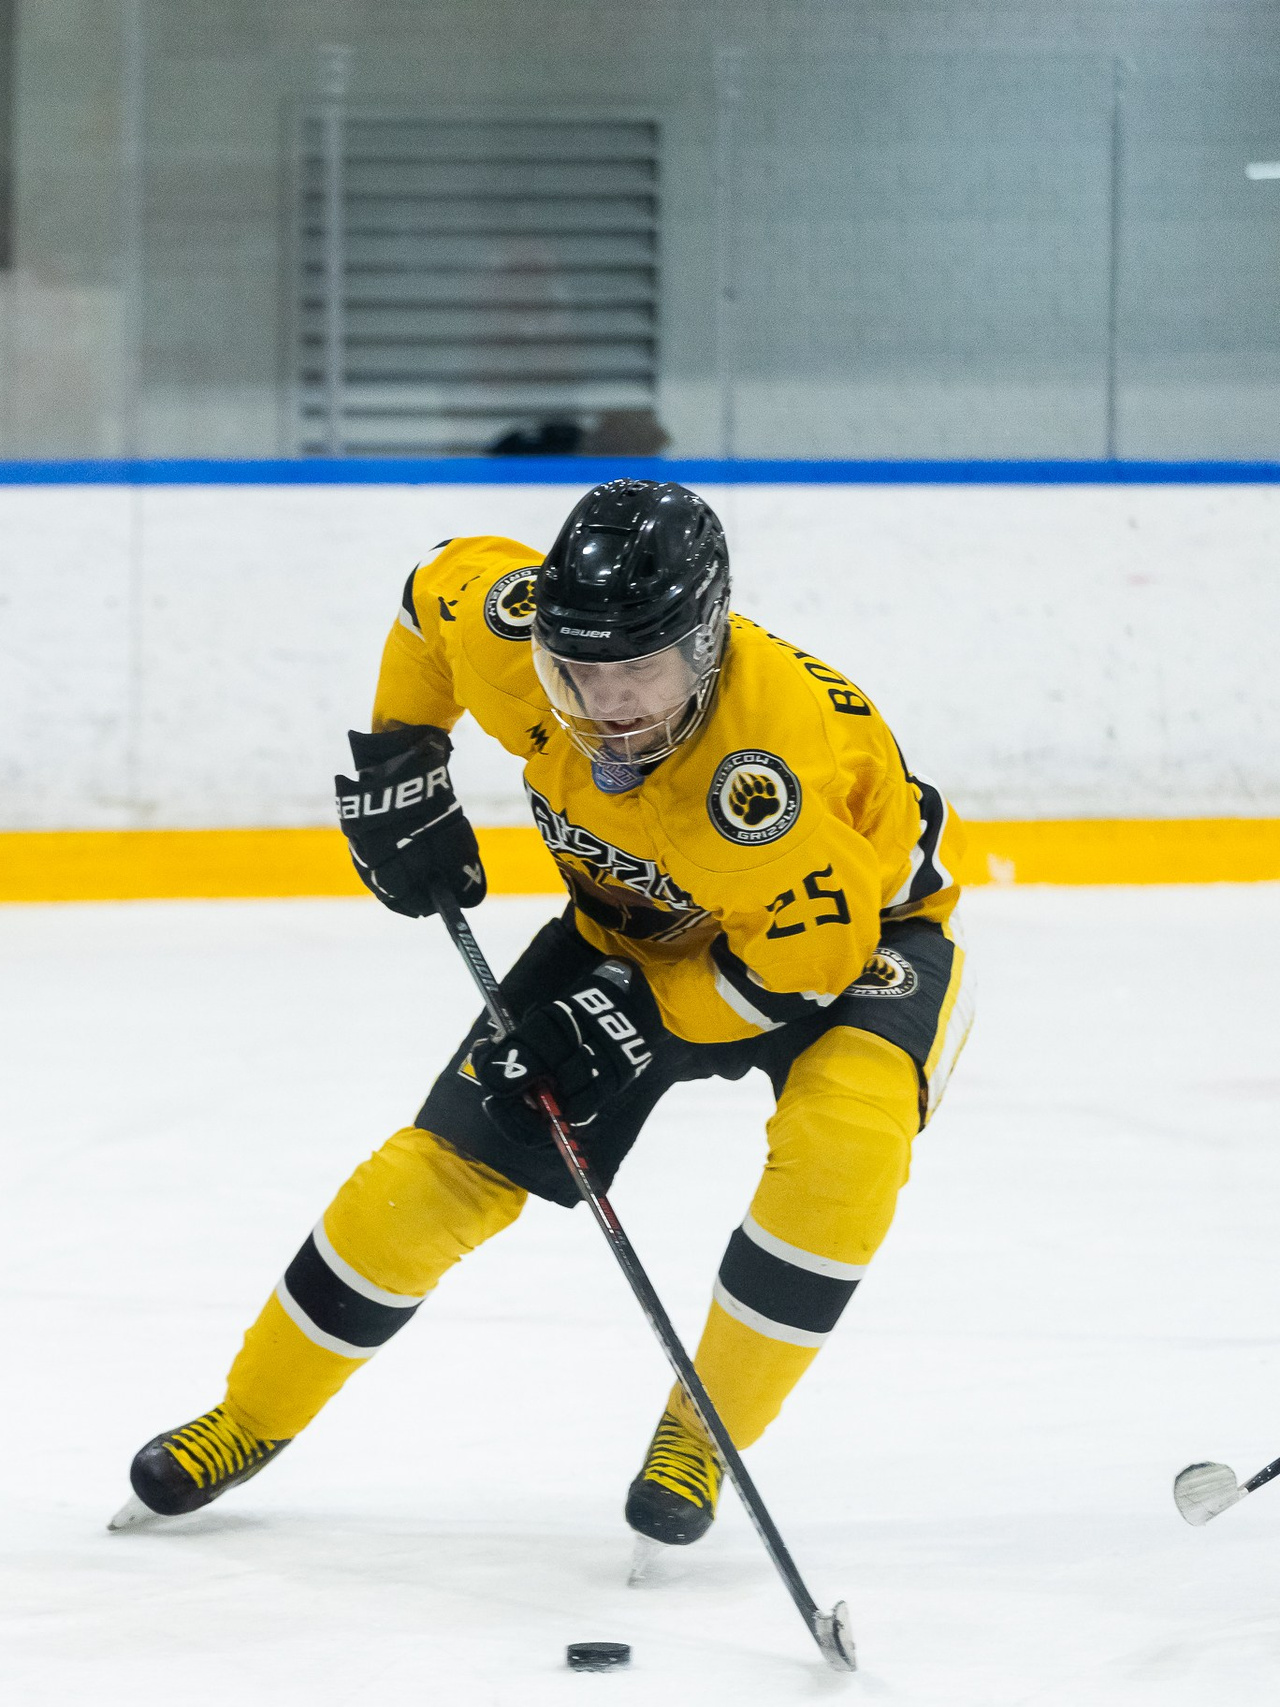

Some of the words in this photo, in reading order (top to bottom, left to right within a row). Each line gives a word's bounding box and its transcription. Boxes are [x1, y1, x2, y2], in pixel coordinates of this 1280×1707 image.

[559, 626, 613, 640] BAUER
[737, 800, 797, 841] GRIZZLY
[764, 863, 852, 940] 25
[572, 987, 653, 1078] BAU
